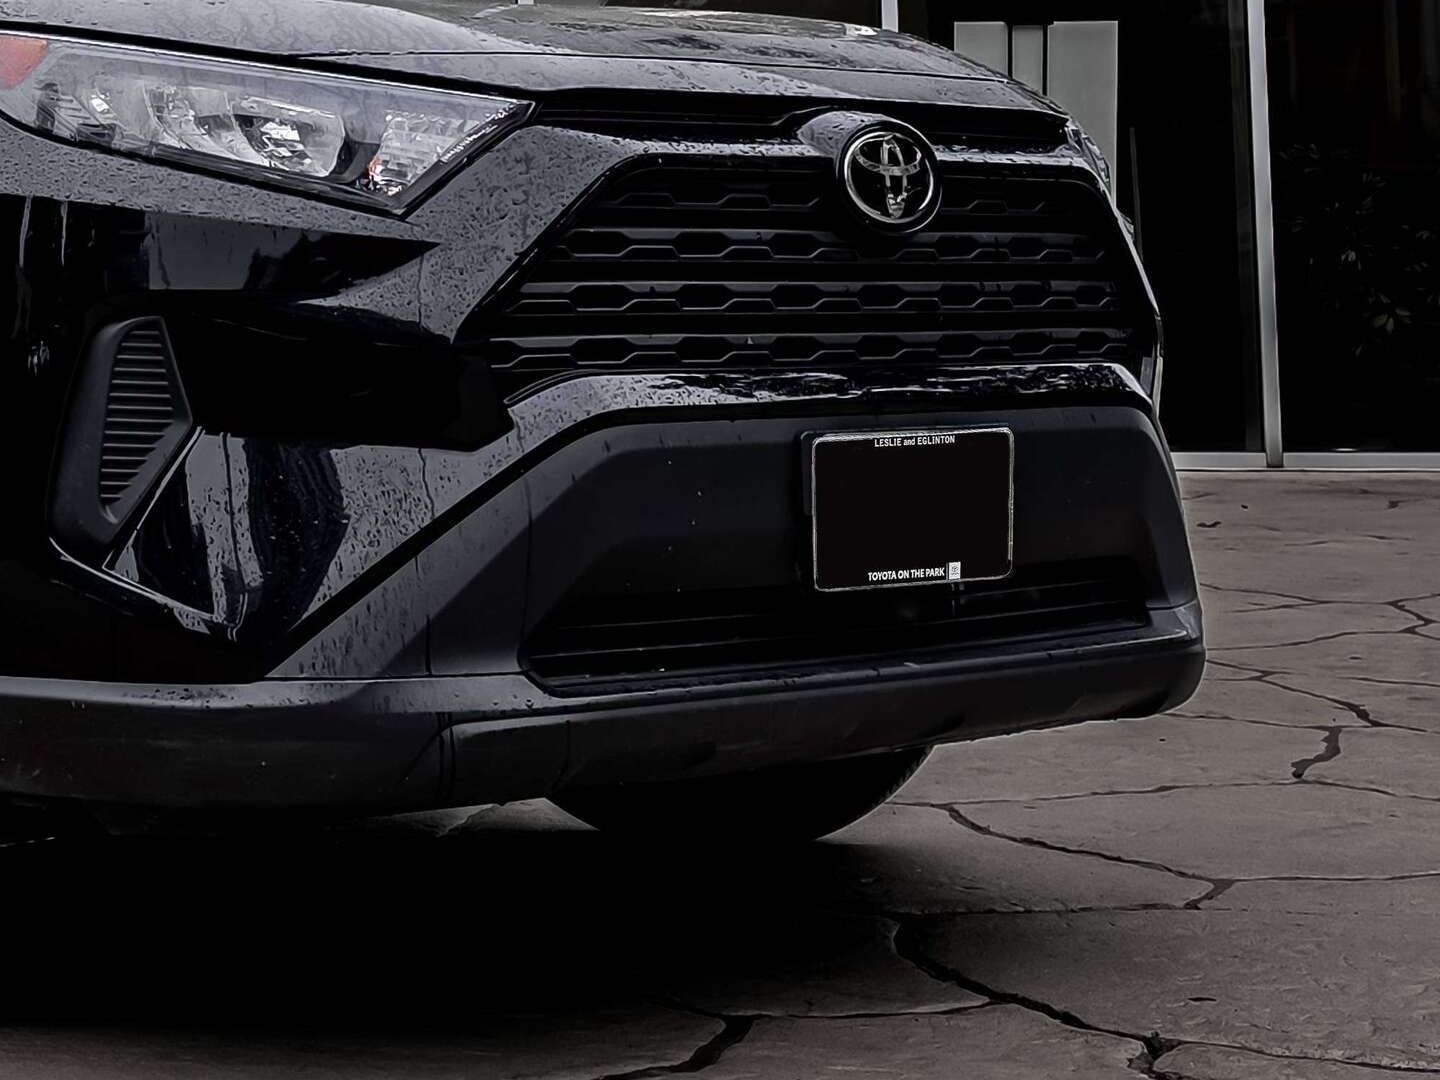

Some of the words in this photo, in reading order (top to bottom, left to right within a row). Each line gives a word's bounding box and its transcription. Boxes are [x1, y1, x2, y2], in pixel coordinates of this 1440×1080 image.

[874, 438, 902, 447] LESLIE
[903, 437, 916, 446] and
[917, 435, 956, 445] EGLINTON
[868, 571, 897, 581] TOYOTA
[898, 569, 910, 579] ON
[910, 568, 925, 579] THE
[925, 567, 945, 577] PARK
